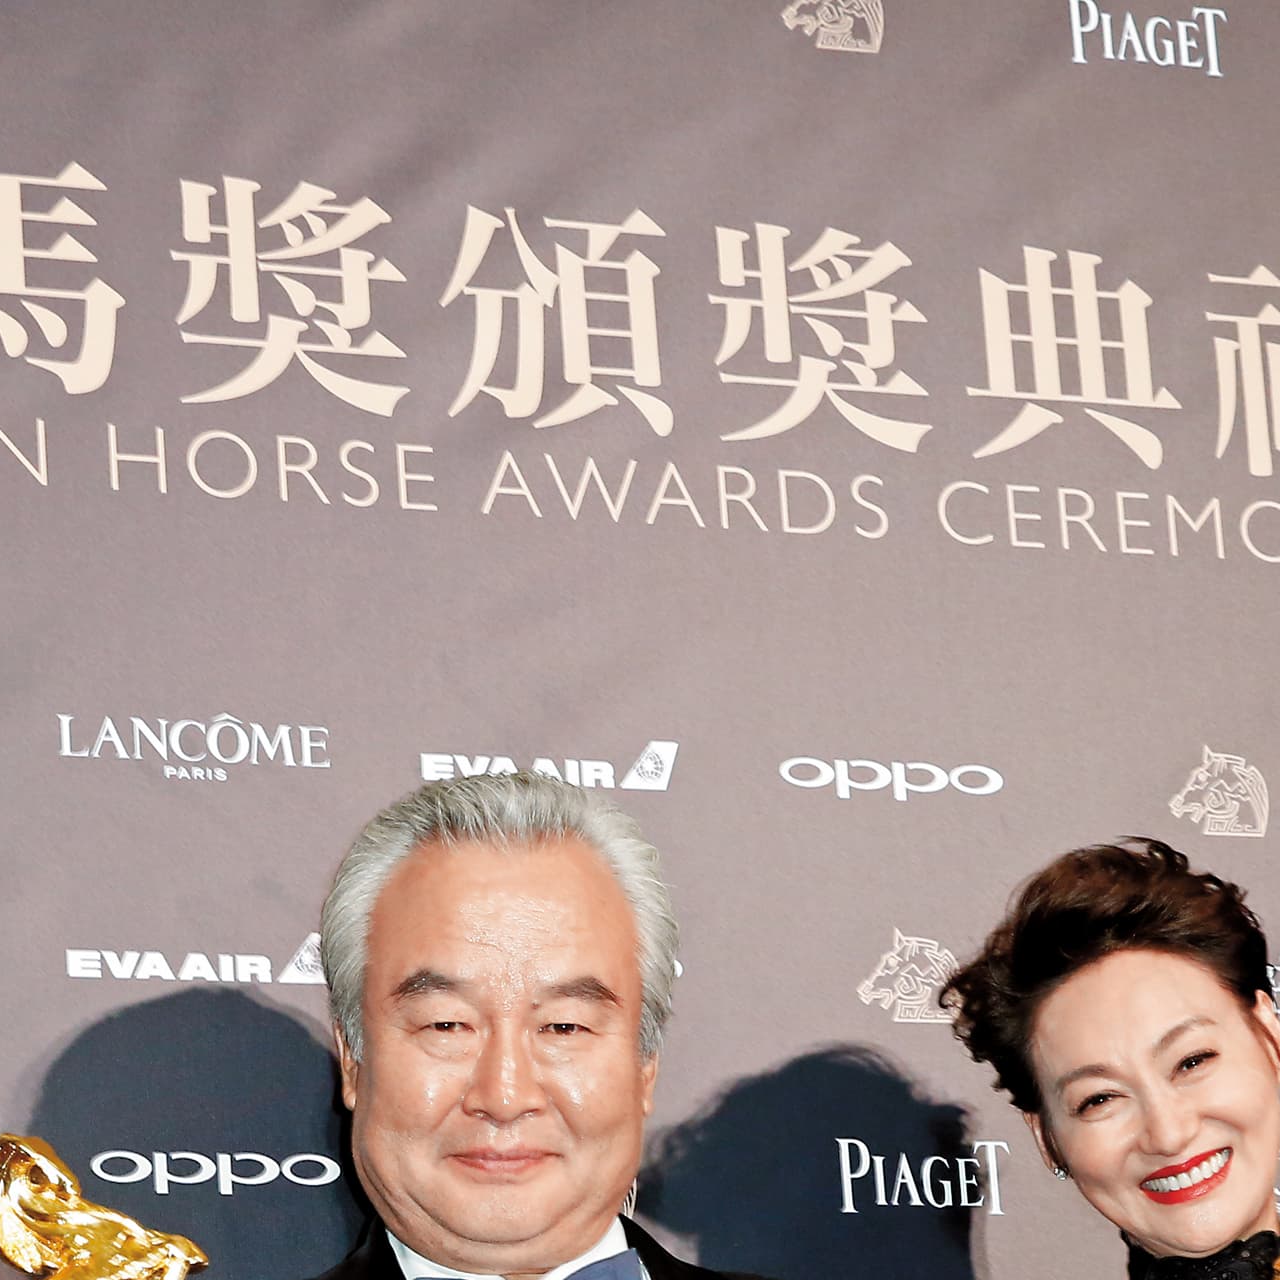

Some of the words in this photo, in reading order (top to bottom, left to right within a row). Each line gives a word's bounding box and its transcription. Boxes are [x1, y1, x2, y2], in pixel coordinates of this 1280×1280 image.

[1070, 0, 1226, 76] PIAGET
[108, 424, 437, 510] HORSE
[483, 451, 888, 538] AWARDS
[57, 713, 330, 767] LANCÔME
[164, 766, 227, 781] PARIS
[780, 758, 1003, 801] oppo
[91, 1151, 340, 1194] oppo
[835, 1138, 1009, 1214] PIAGET
